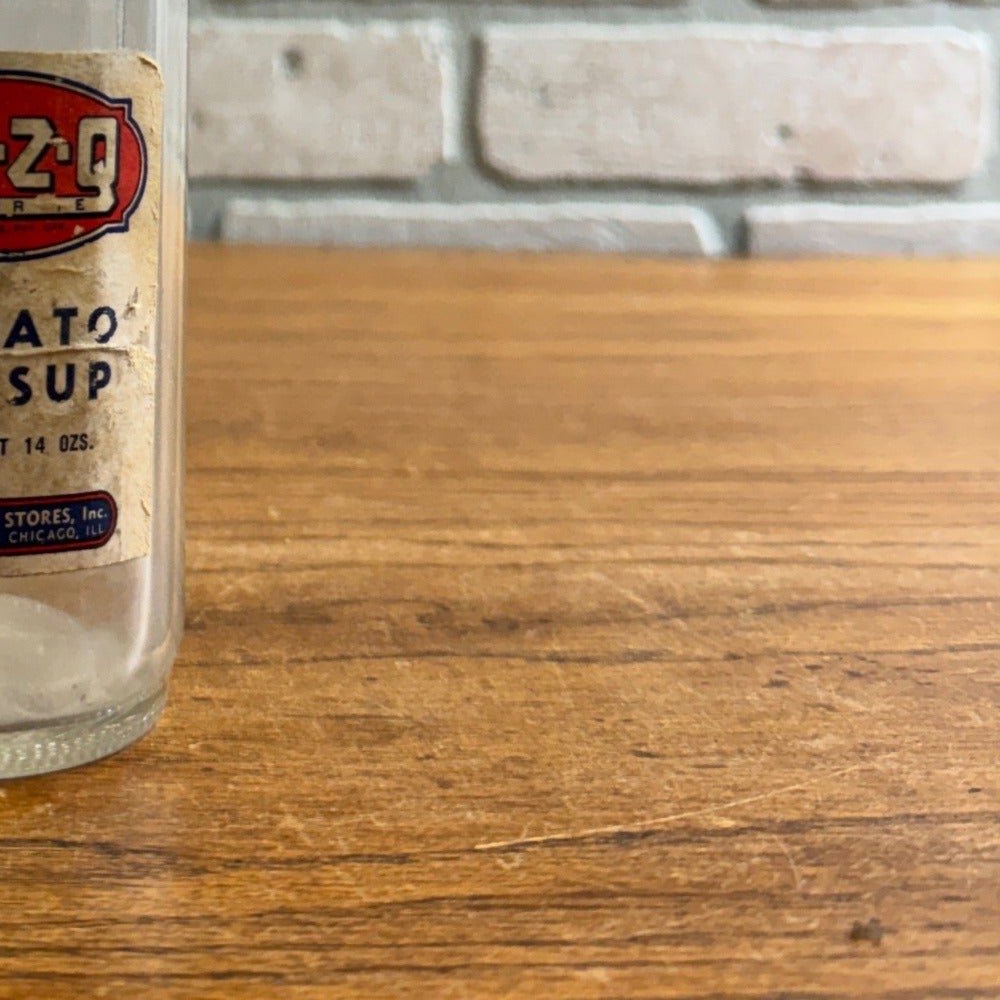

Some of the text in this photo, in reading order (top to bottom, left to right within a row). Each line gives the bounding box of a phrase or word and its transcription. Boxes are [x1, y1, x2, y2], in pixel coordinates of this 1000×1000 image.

[24, 436, 46, 455] 14
[58, 433, 95, 454] OZS.
[4, 507, 75, 528] STORES,
[82, 506, 108, 521] Inc.
